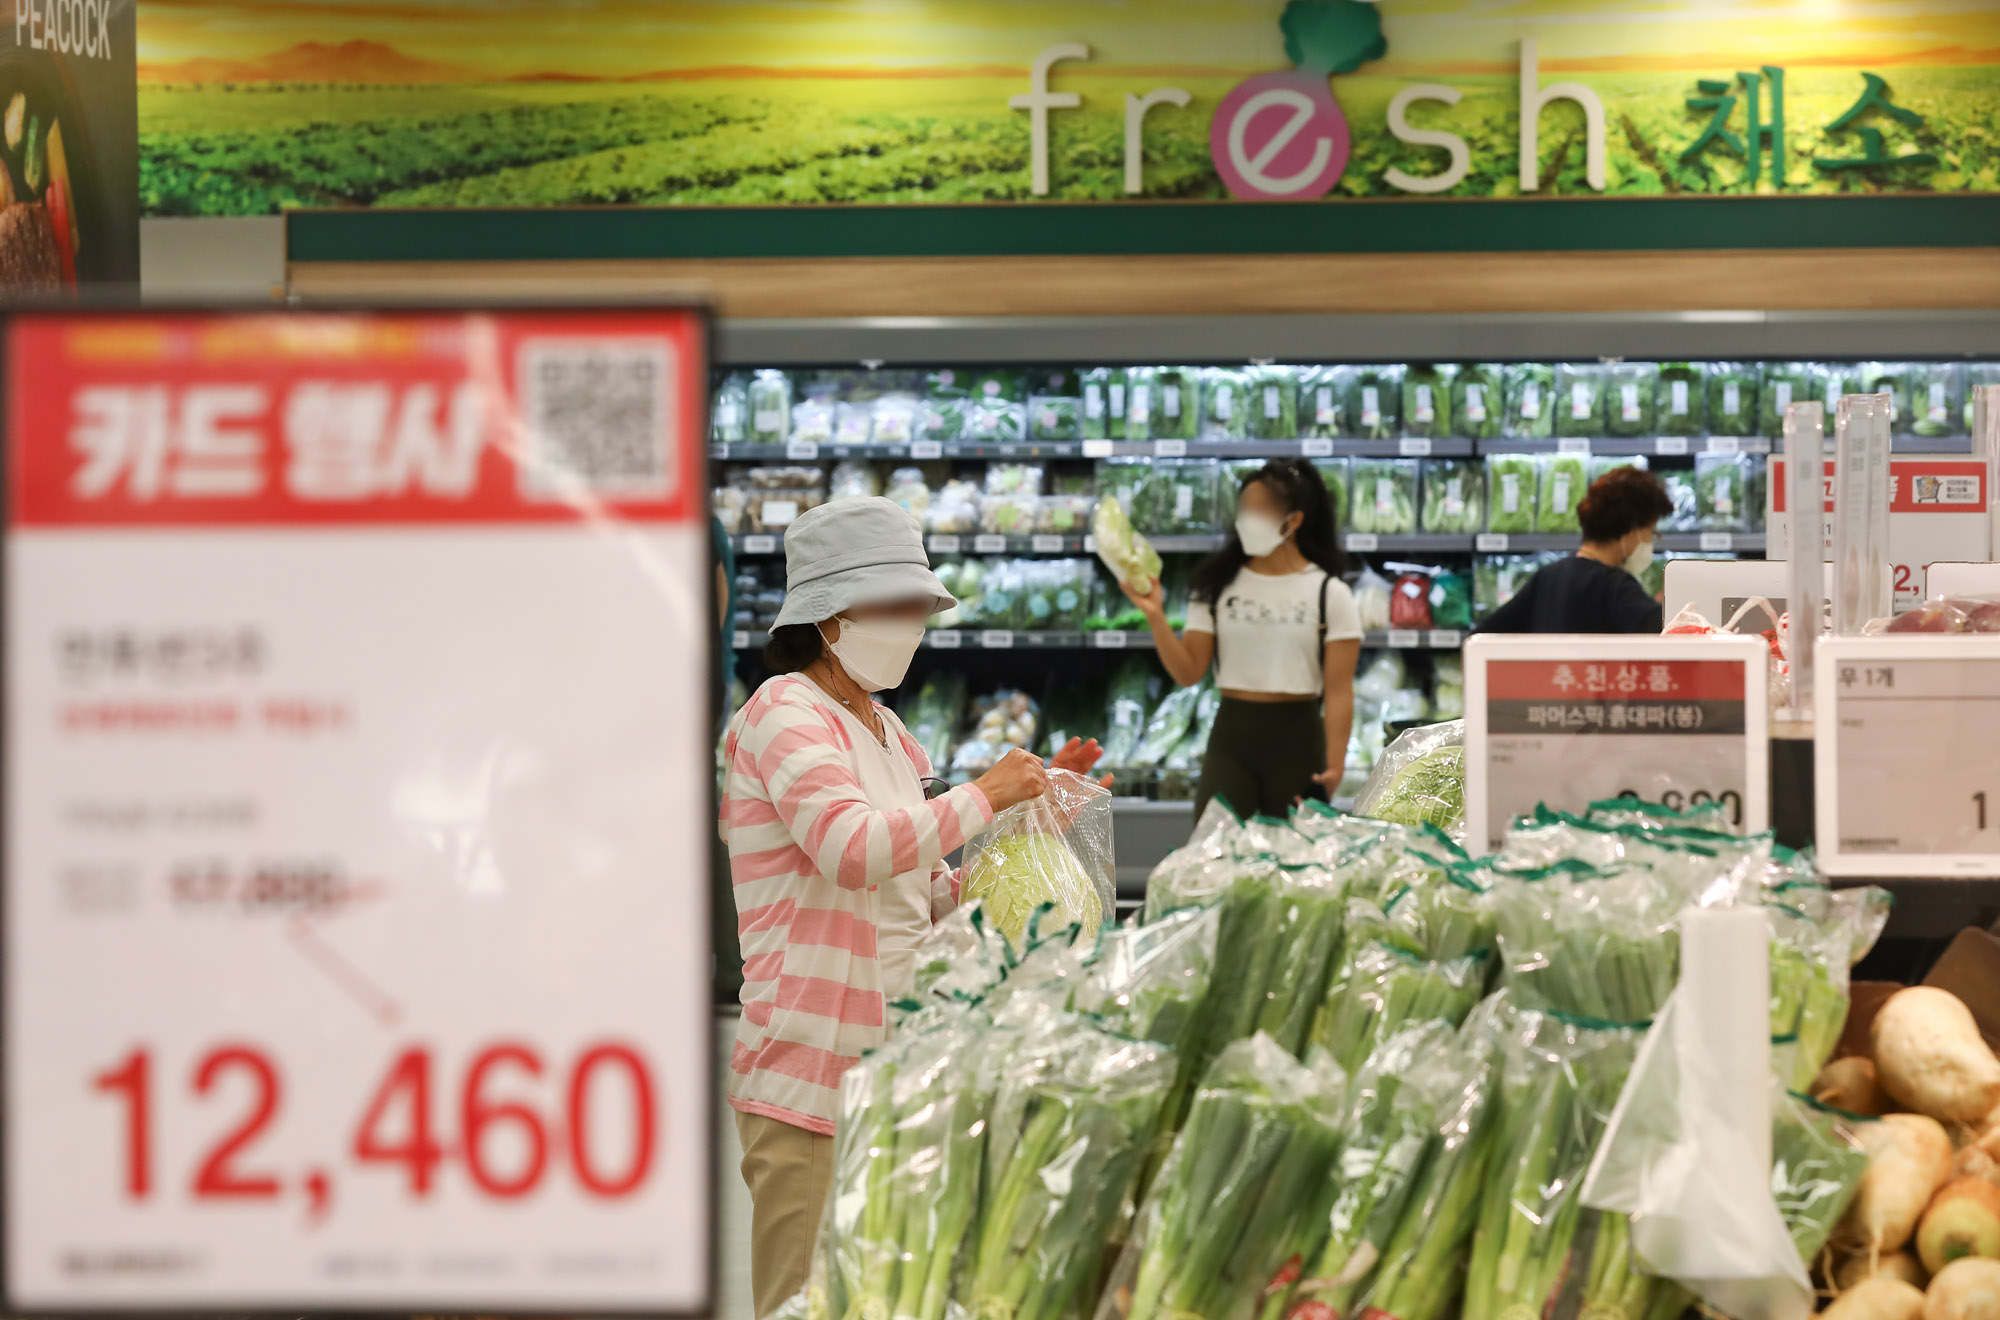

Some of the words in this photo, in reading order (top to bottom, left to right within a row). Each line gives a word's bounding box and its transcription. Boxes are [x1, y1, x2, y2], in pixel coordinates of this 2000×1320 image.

[15, 0, 112, 60] PEACOCK
[1009, 36, 1606, 195] fresh
[1681, 66, 1937, 189] 채소
[70, 383, 268, 500] 카드
[91, 1042, 659, 1231] 12,460
